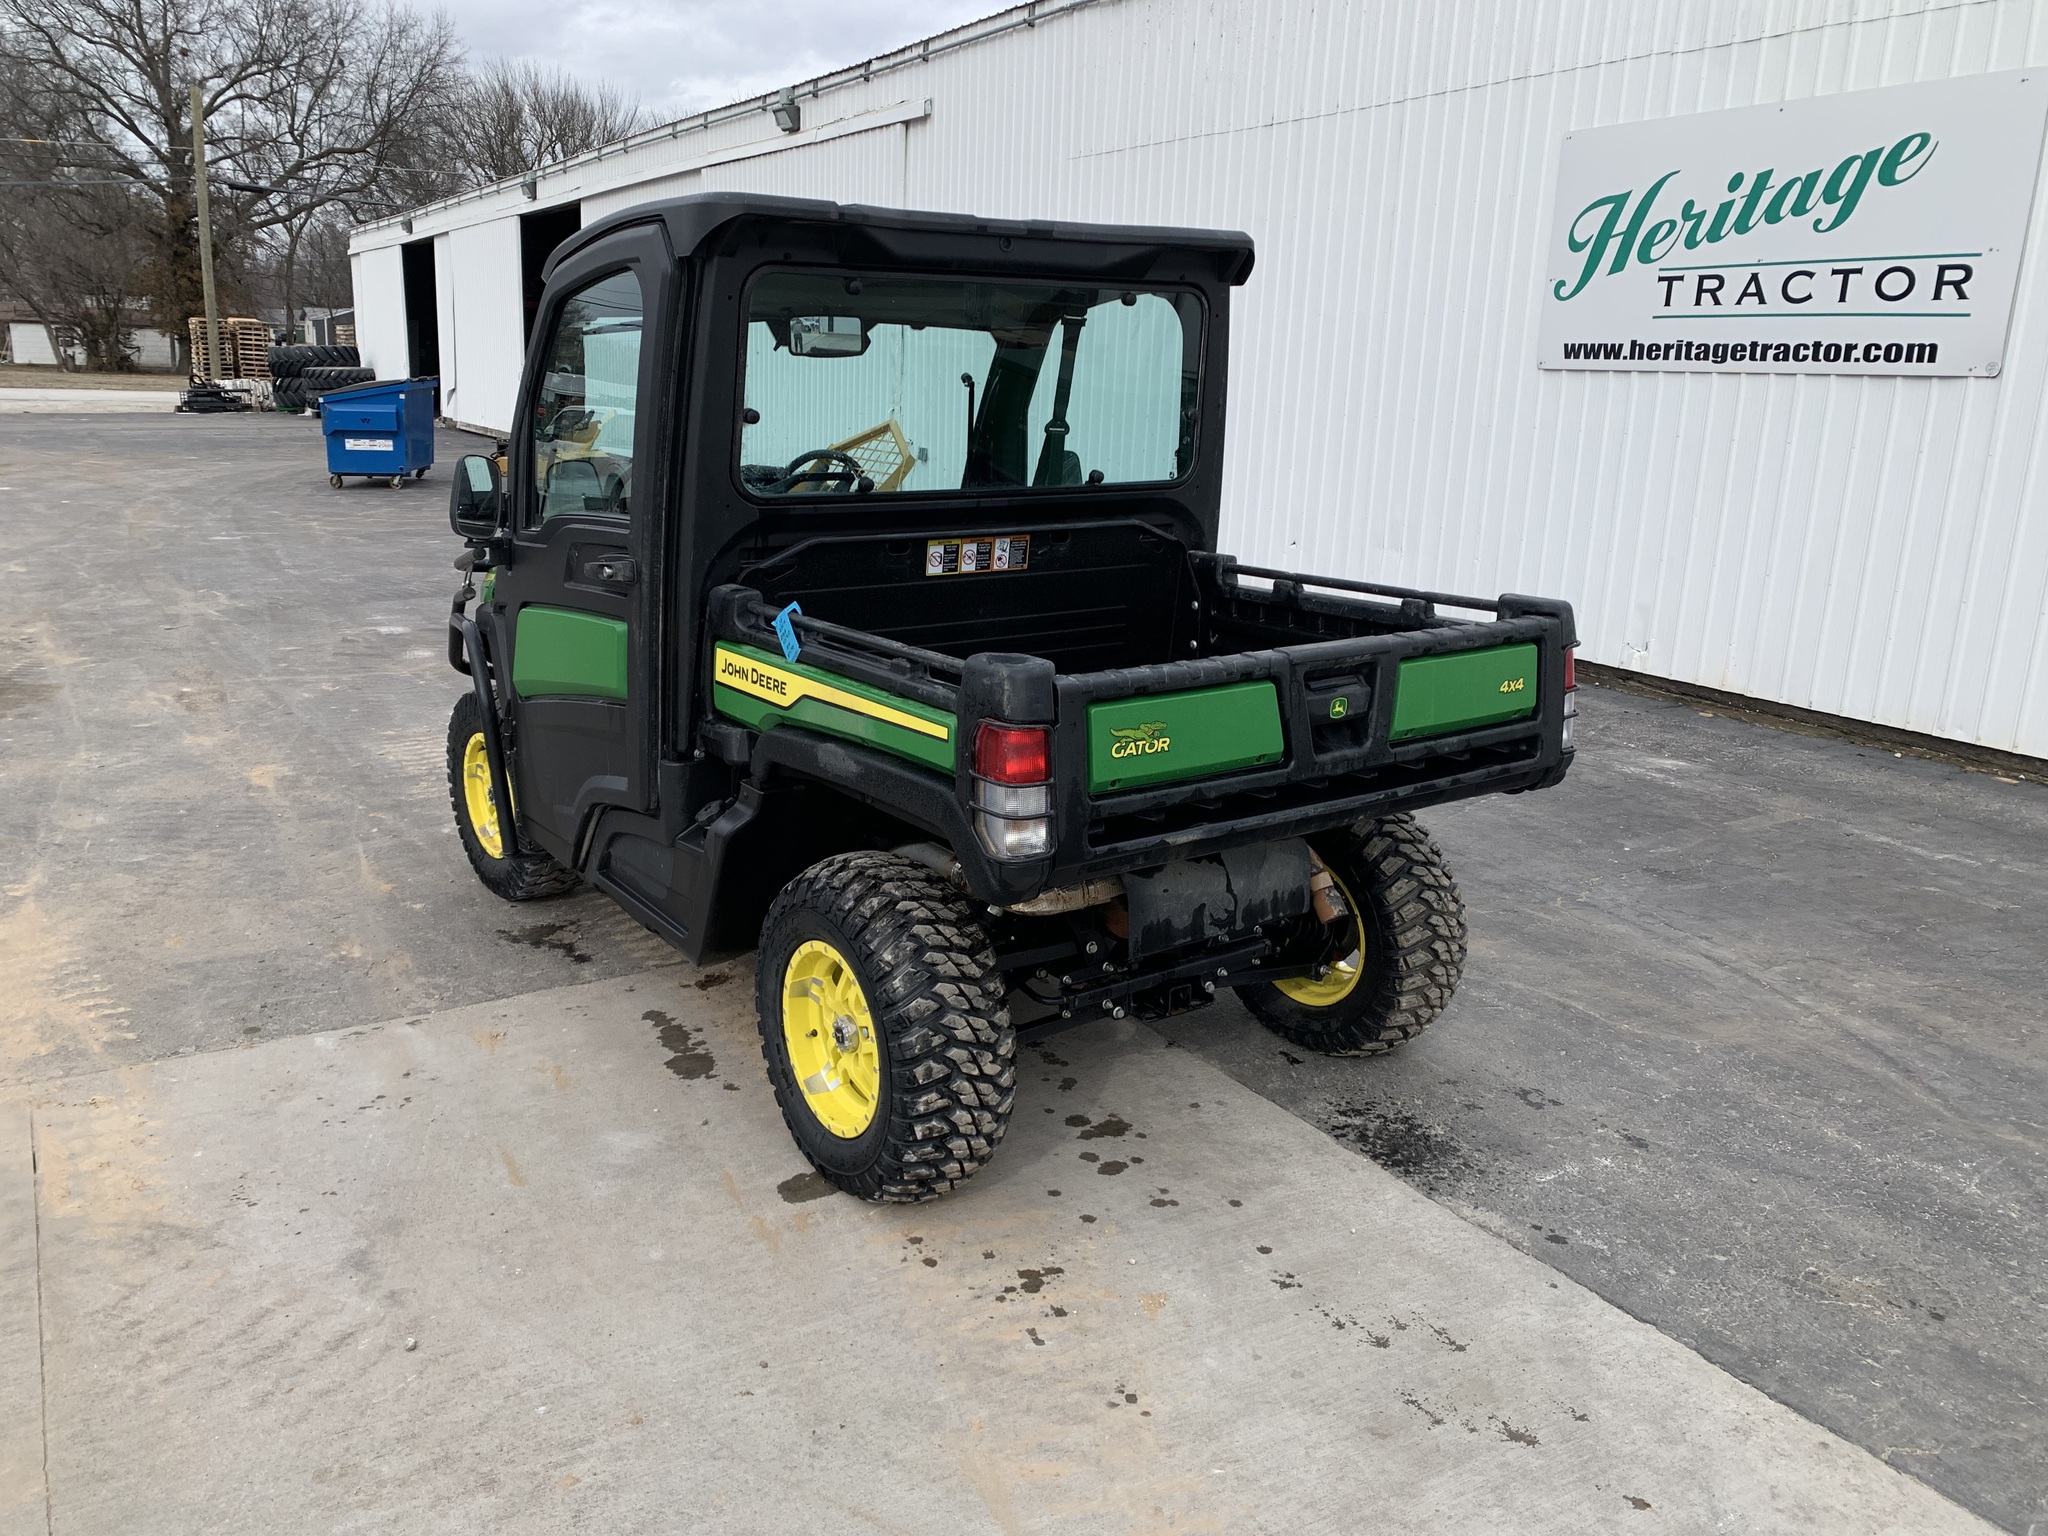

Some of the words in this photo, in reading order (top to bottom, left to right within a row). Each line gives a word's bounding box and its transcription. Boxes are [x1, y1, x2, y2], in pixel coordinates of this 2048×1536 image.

[1554, 132, 1939, 301] Heritage
[1657, 264, 1973, 306] TRACTOR
[1563, 339, 1939, 364] www.heritagetractor.com
[1111, 737, 1170, 758] GATOR
